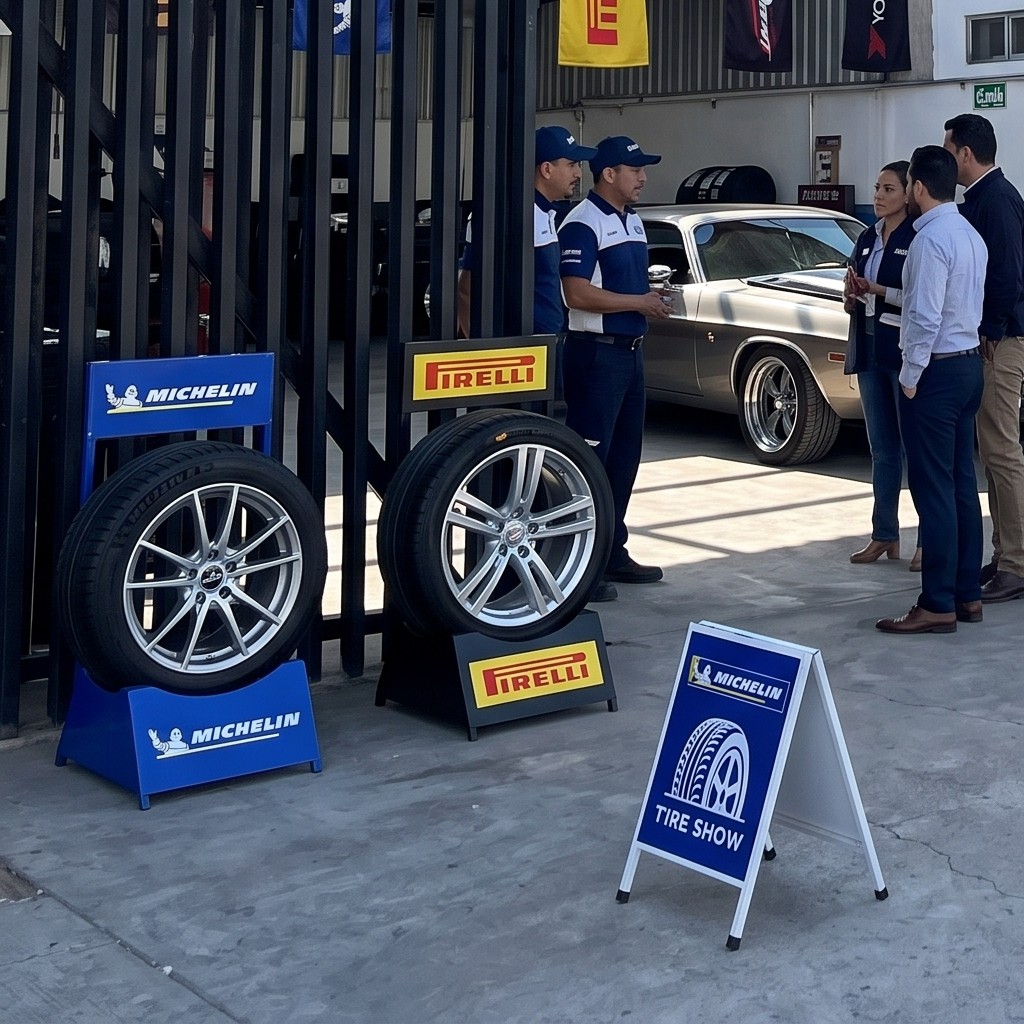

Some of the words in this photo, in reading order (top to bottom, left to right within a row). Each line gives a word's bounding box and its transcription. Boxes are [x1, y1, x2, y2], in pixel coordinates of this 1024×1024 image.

[425, 355, 536, 391] PIRELLI
[145, 382, 258, 403] MICHELIN
[482, 652, 588, 697] PIRELLI
[713, 671, 783, 701] MICHELIN
[190, 711, 301, 745] MICHELIN
[655, 804, 691, 833] TIRE
[692, 819, 745, 852] SHOW
